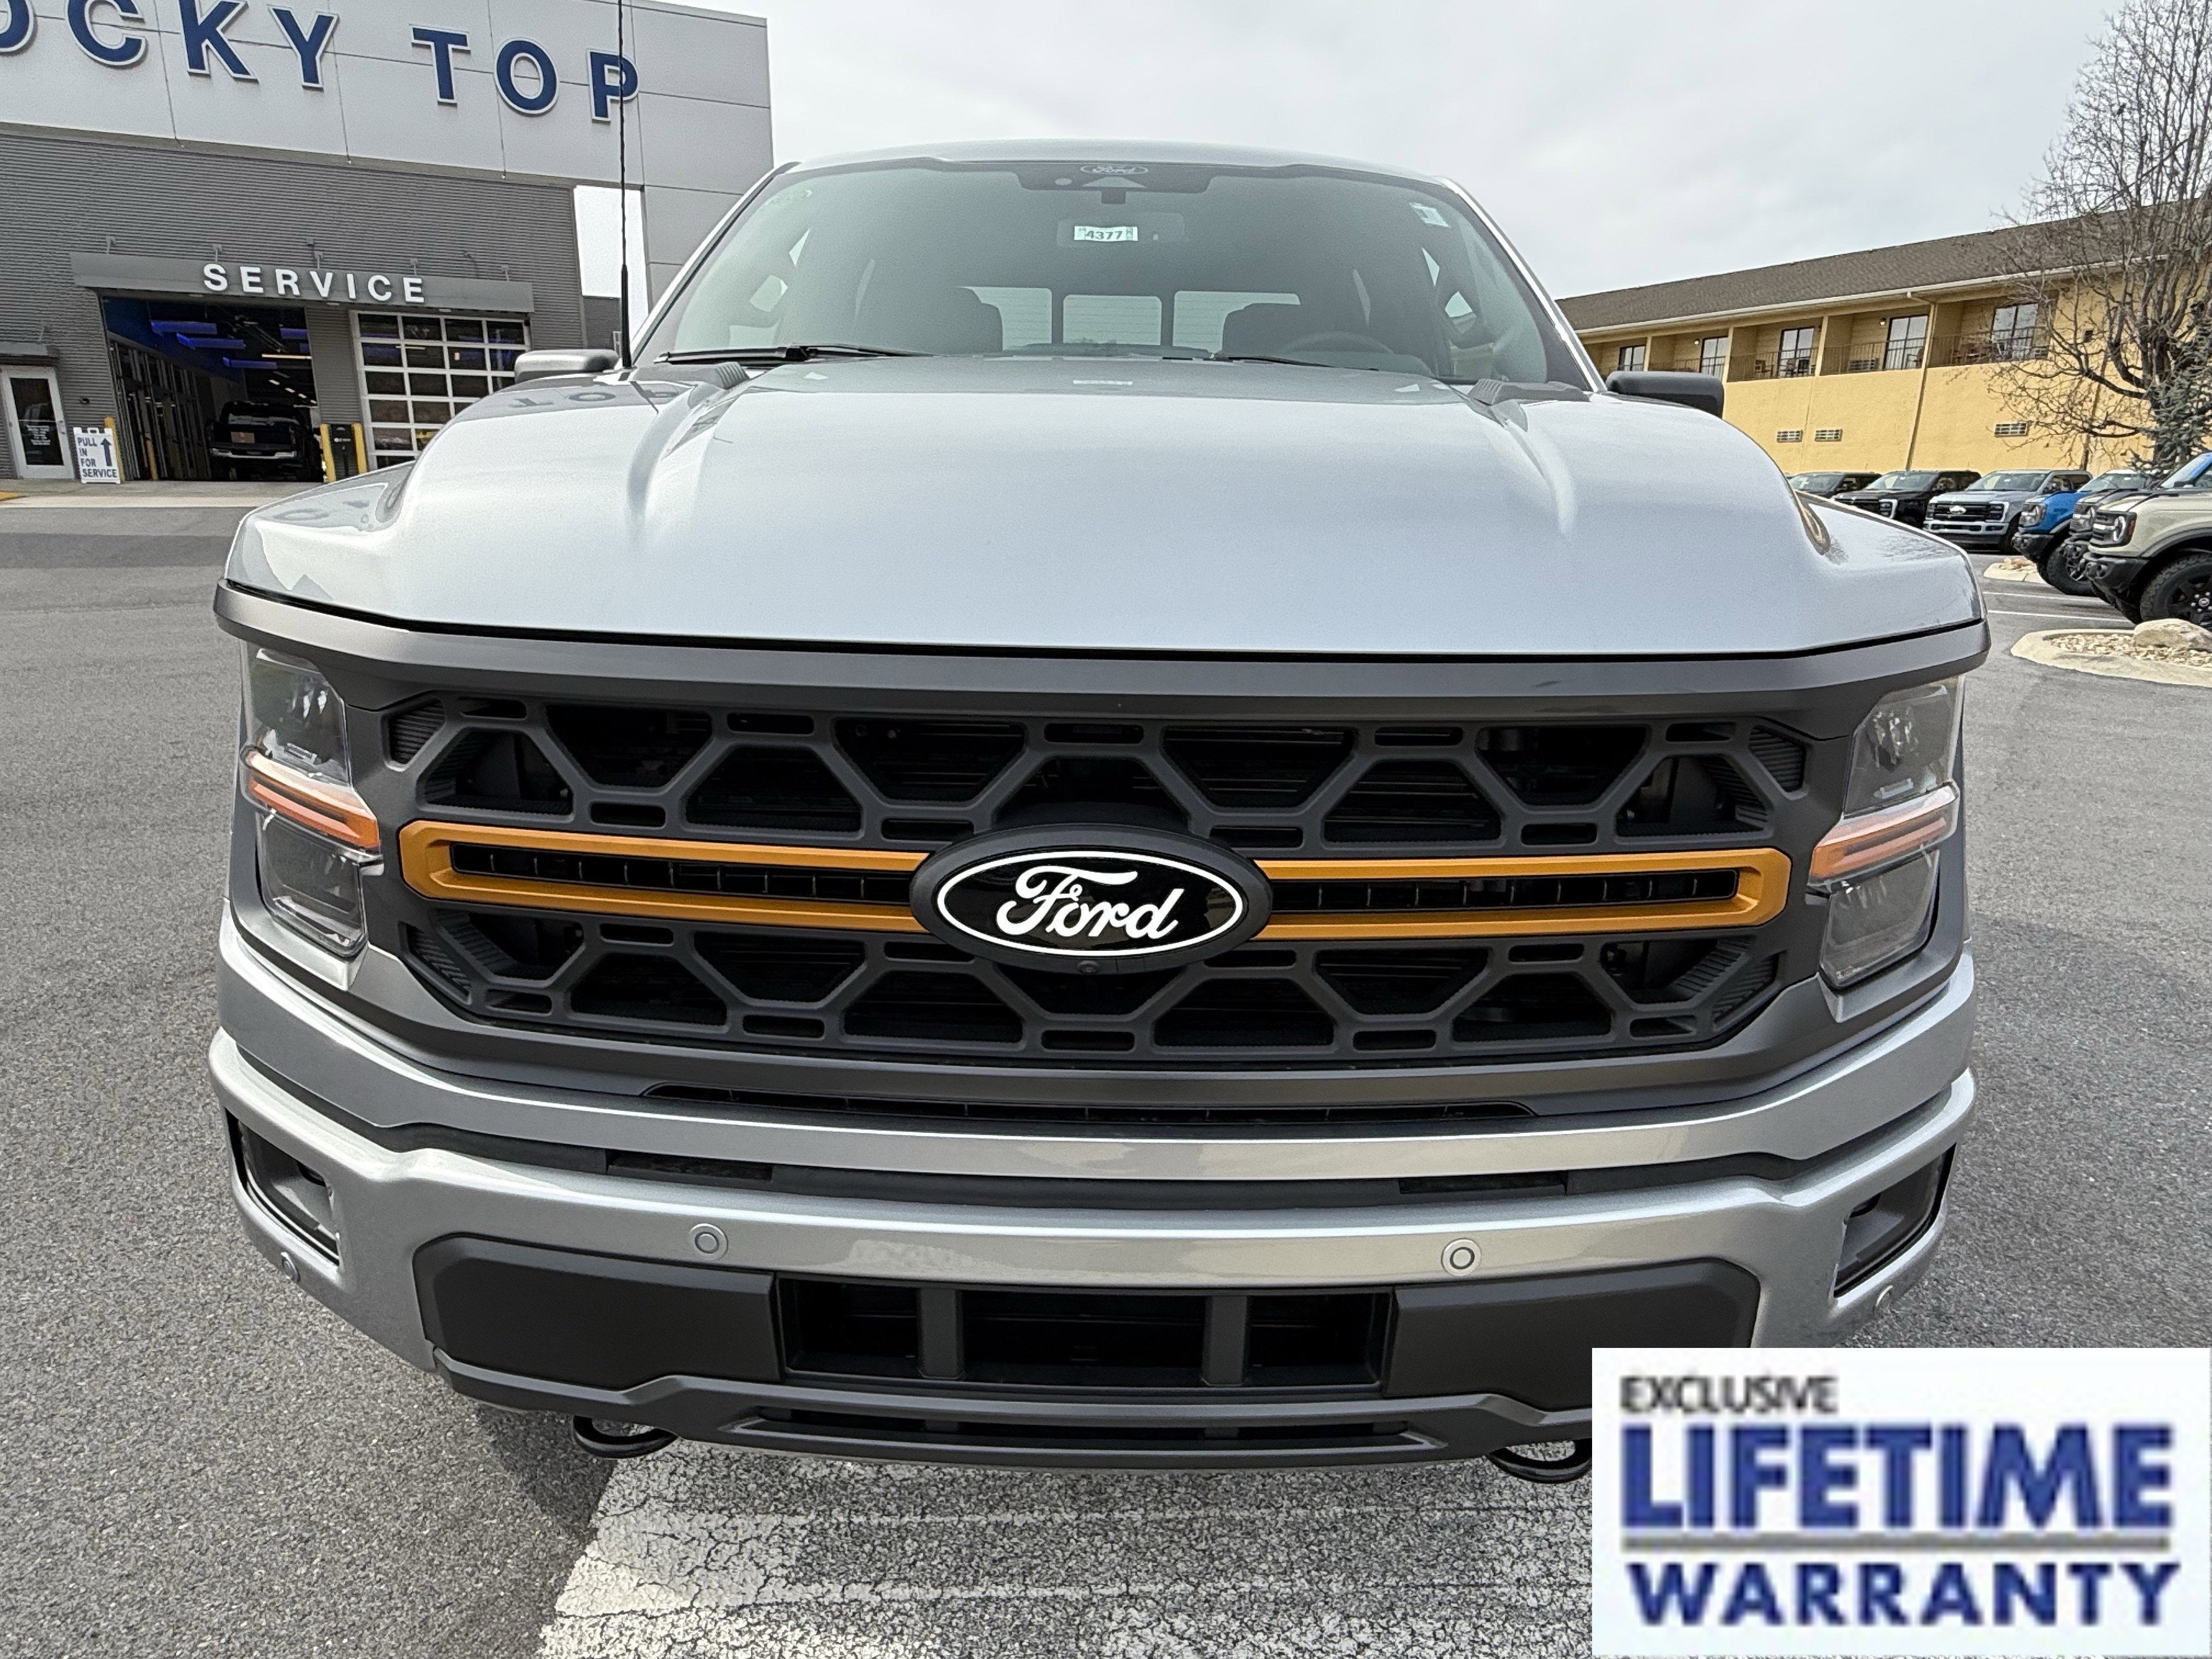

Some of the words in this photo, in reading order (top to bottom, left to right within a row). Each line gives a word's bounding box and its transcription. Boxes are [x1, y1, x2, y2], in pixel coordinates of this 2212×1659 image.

[410, 24, 639, 123] TOP
[1085, 230, 1123, 240] 4377
[203, 263, 425, 303] SERVICE
[77, 437, 98, 447] PULL
[78, 448, 88, 457] IN
[80, 458, 97, 467] FOR
[82, 469, 117, 478] SERVICE
[996, 865, 1185, 939] Ford
